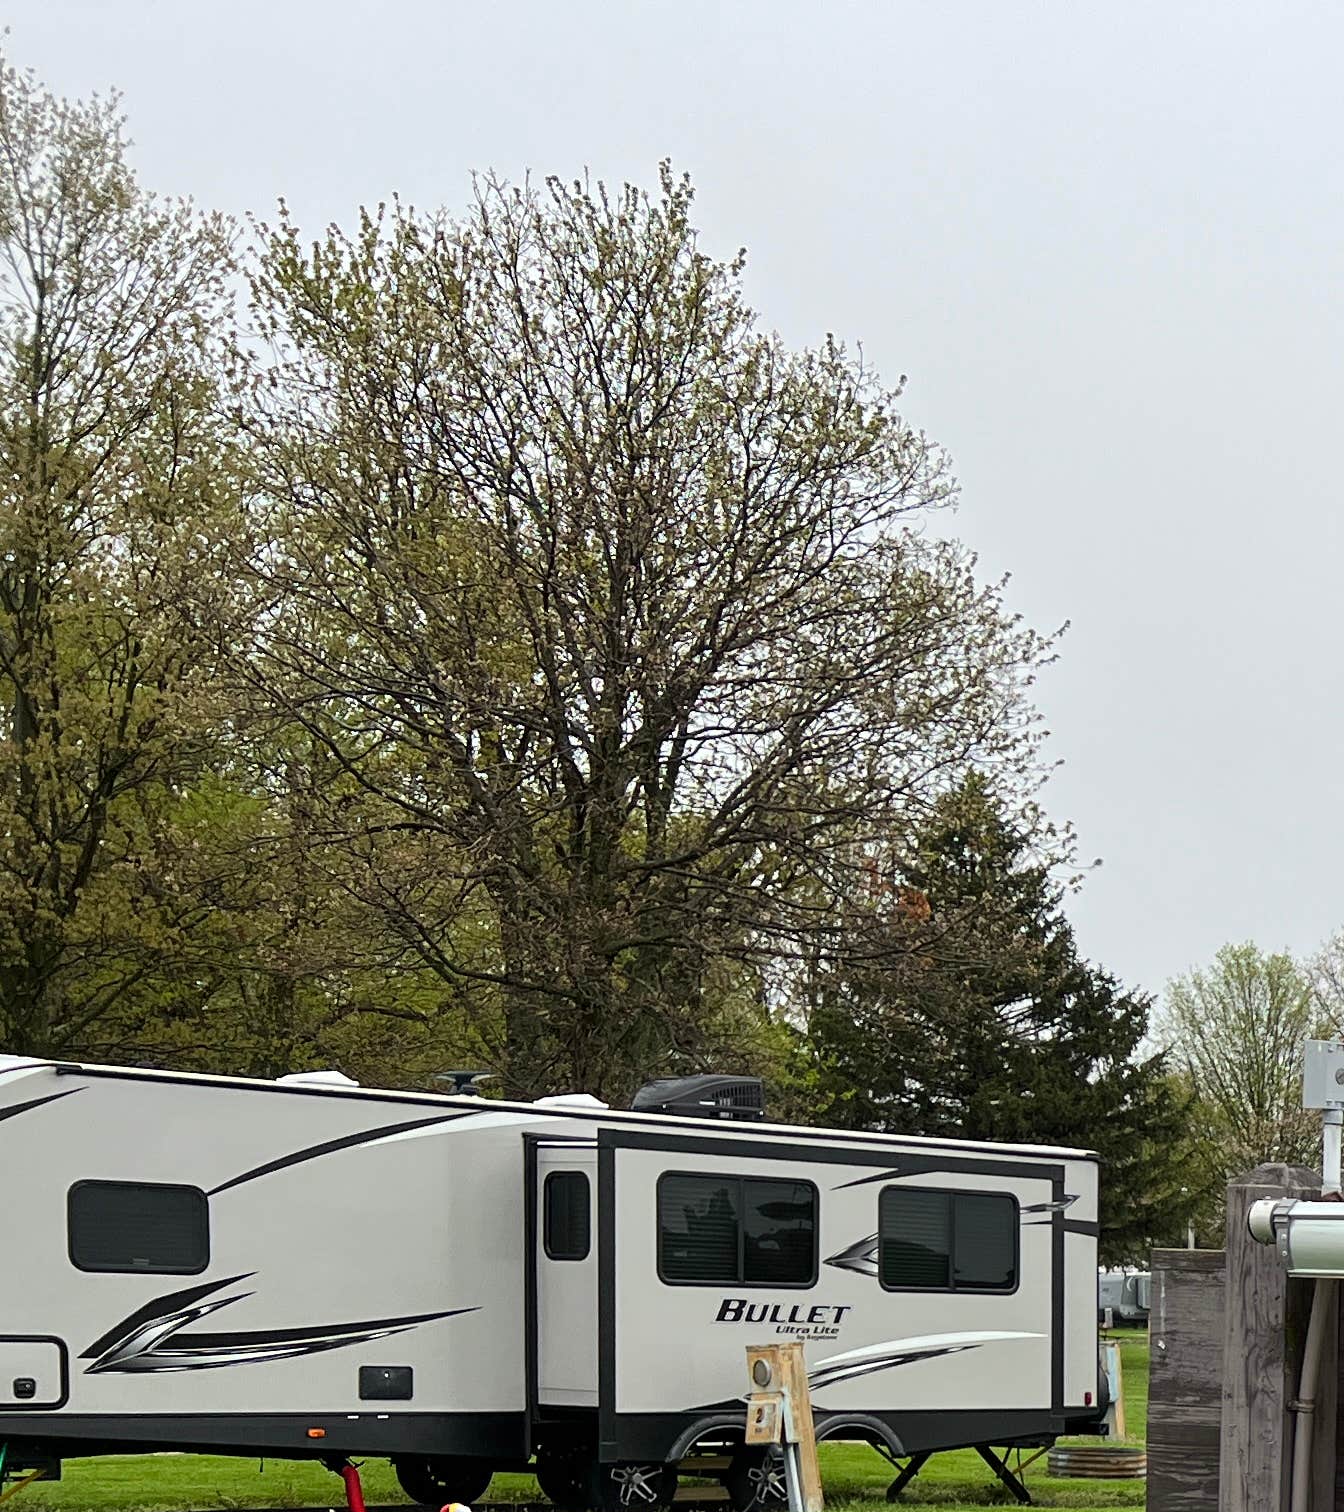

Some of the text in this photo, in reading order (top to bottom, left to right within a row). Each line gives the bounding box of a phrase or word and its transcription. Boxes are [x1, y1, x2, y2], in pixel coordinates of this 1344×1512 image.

[715, 1299, 851, 1324] BULLET
[776, 1325, 840, 1334] Ultra Lite
